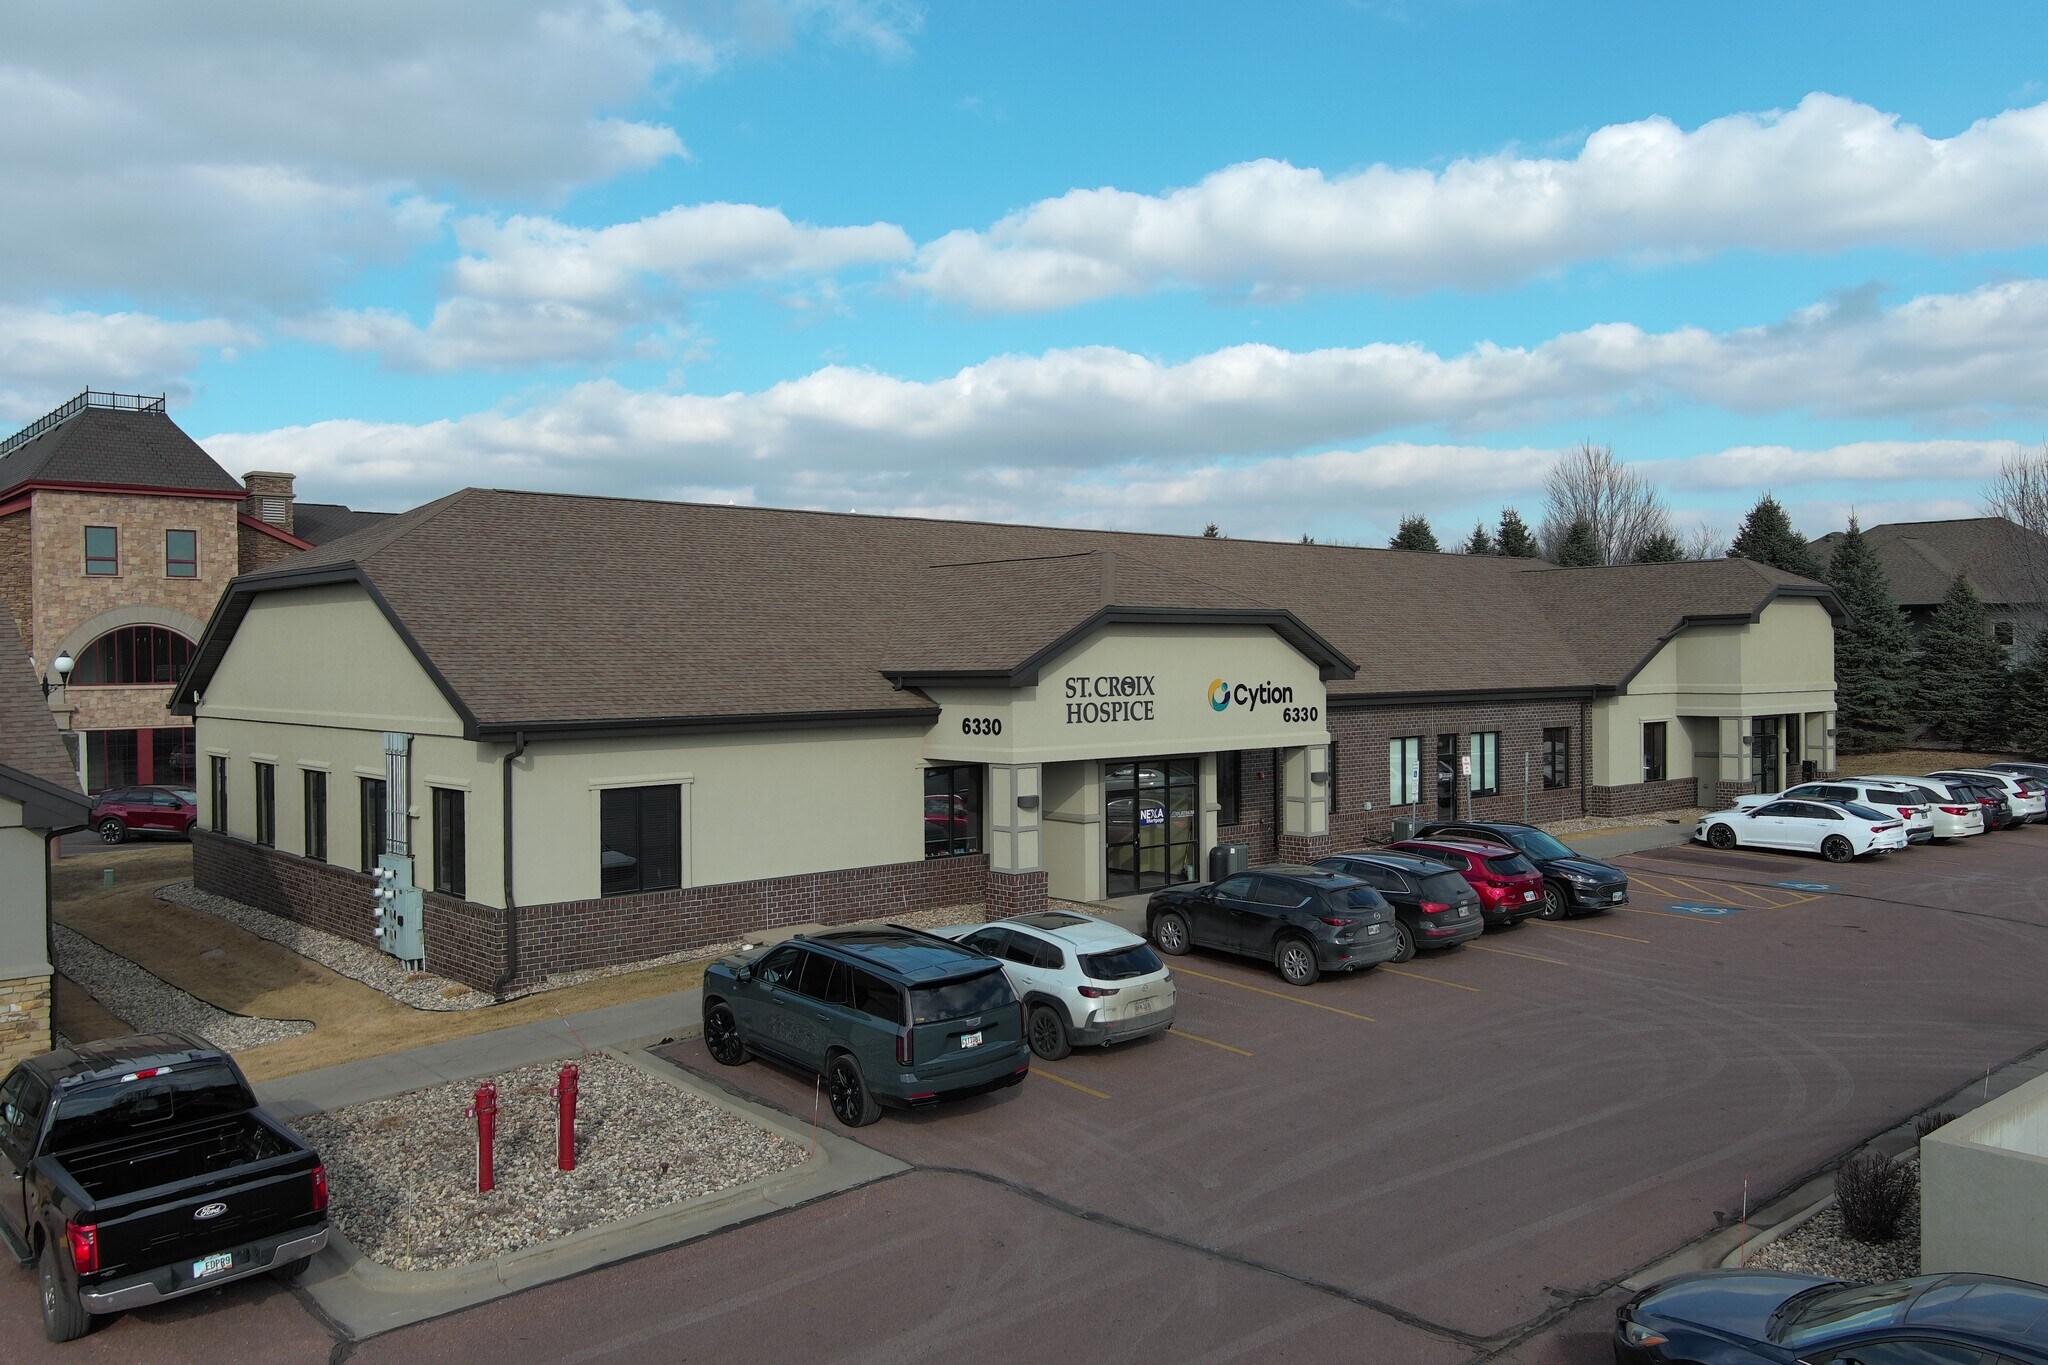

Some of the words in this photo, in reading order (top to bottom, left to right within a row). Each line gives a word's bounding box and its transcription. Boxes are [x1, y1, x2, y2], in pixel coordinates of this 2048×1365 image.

[1065, 677, 1092, 699] ST.
[1094, 676, 1155, 698] CROIX
[1233, 680, 1293, 712] Cytion
[1066, 700, 1155, 724] HOSPICE
[1283, 706, 1318, 722] 6330
[962, 717, 1002, 736] 6330
[1140, 808, 1164, 820] NEXA
